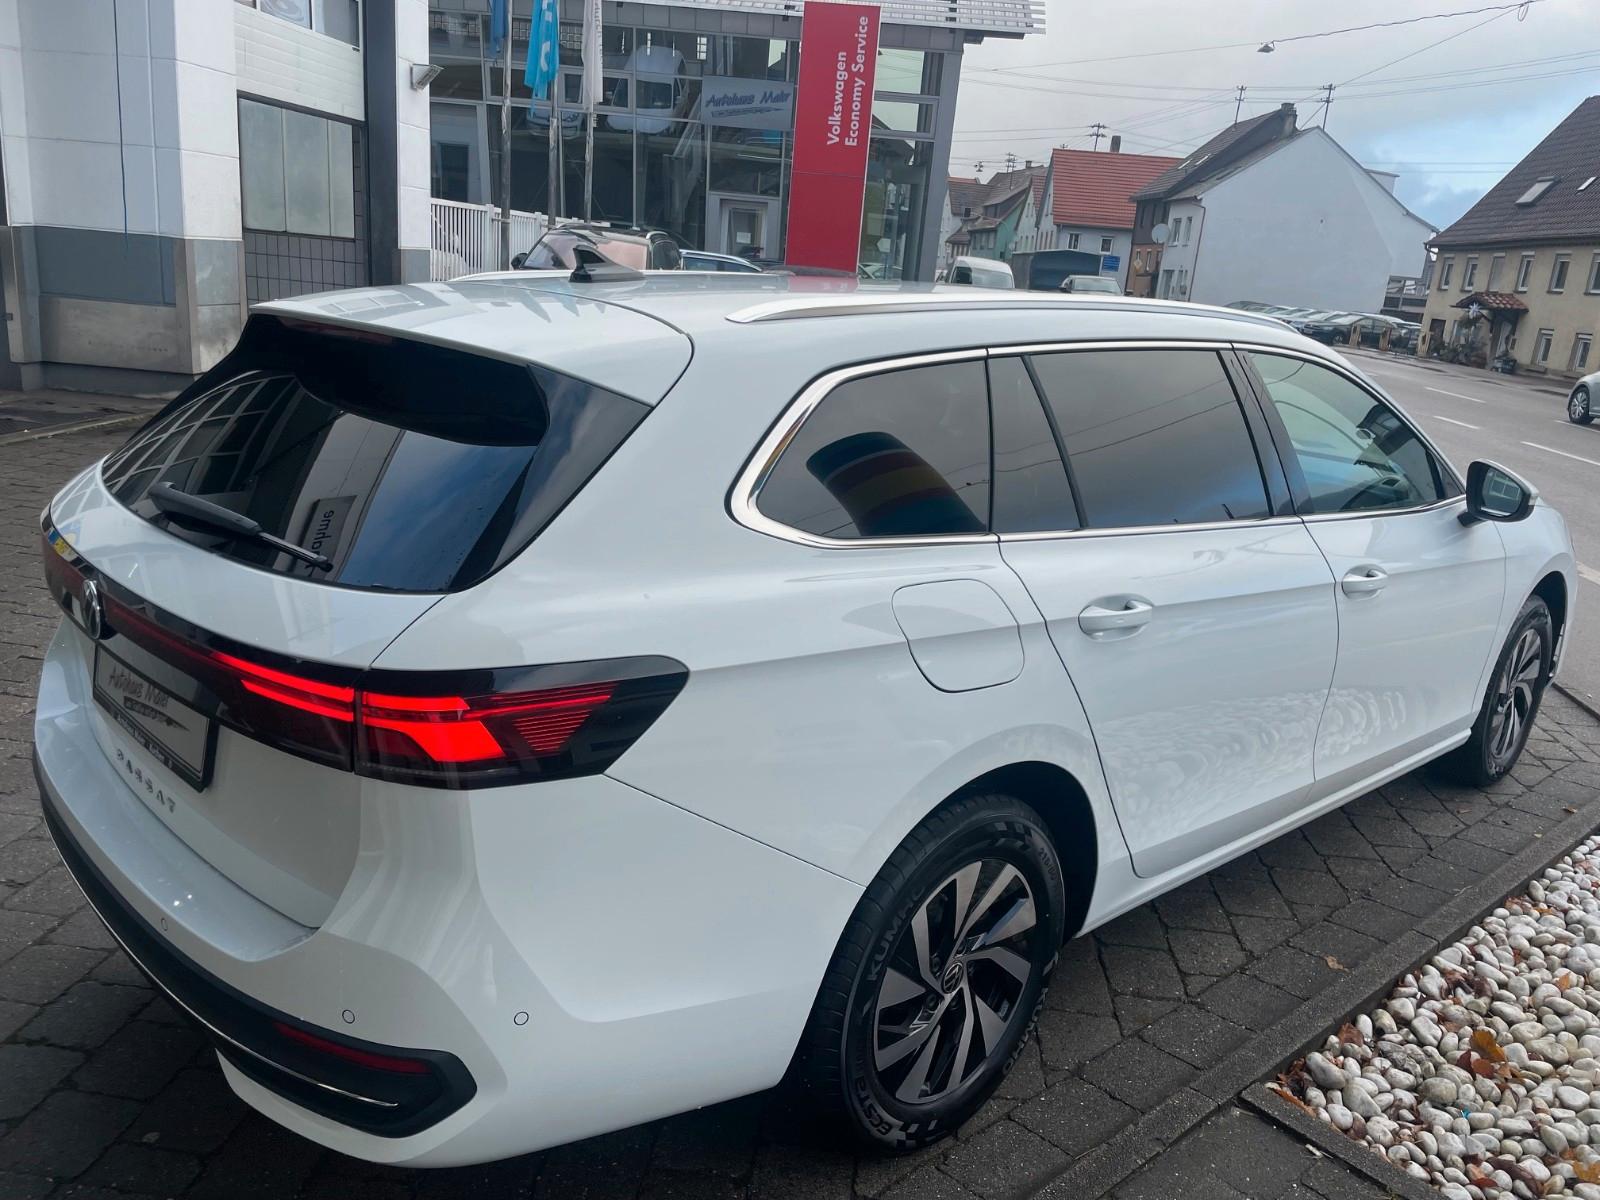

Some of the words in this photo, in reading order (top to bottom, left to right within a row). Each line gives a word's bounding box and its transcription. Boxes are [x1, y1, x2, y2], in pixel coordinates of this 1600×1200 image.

[851, 16, 869, 73] Service
[827, 51, 848, 145] Volkswagen
[845, 77, 866, 146] Economy
[116, 748, 176, 814] PASSAT
